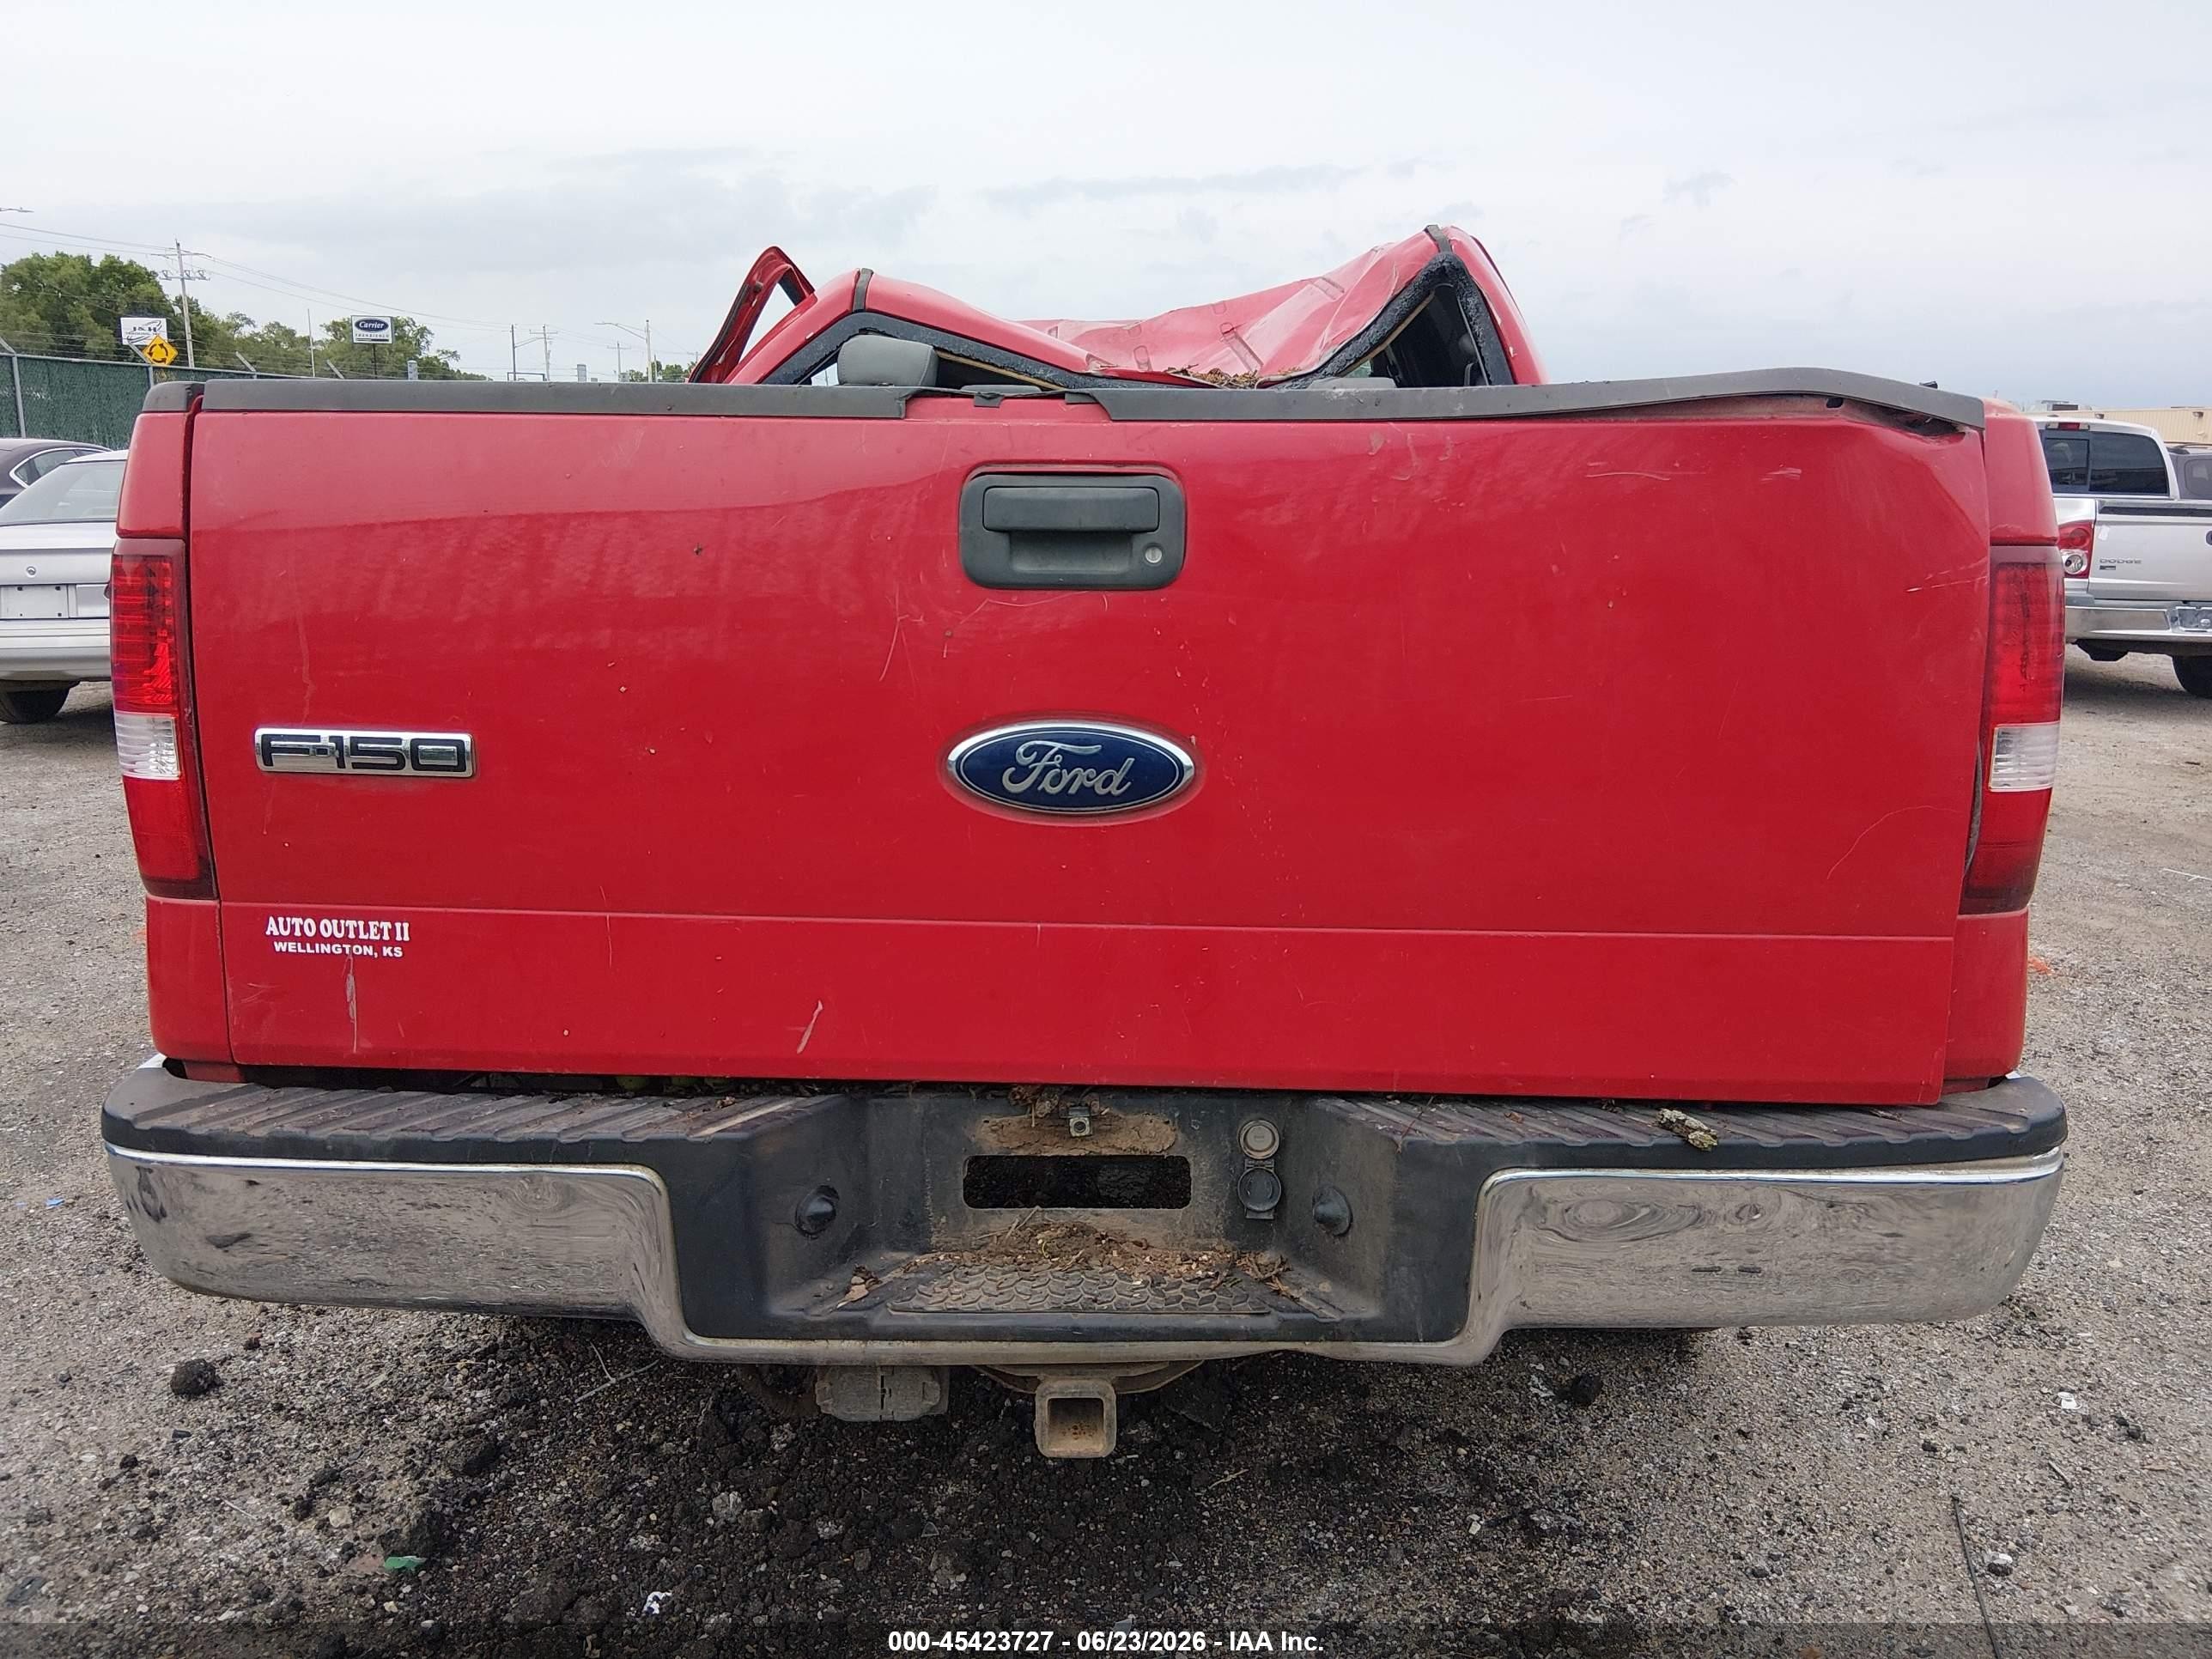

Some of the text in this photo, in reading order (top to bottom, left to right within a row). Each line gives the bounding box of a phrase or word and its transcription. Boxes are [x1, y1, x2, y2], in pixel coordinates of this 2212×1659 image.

[260, 733, 467, 773] F-150
[1001, 739, 1135, 797] Ford
[265, 915, 410, 942] AUTO OUTLET II
[273, 941, 404, 958] WELLINGTON, KS
